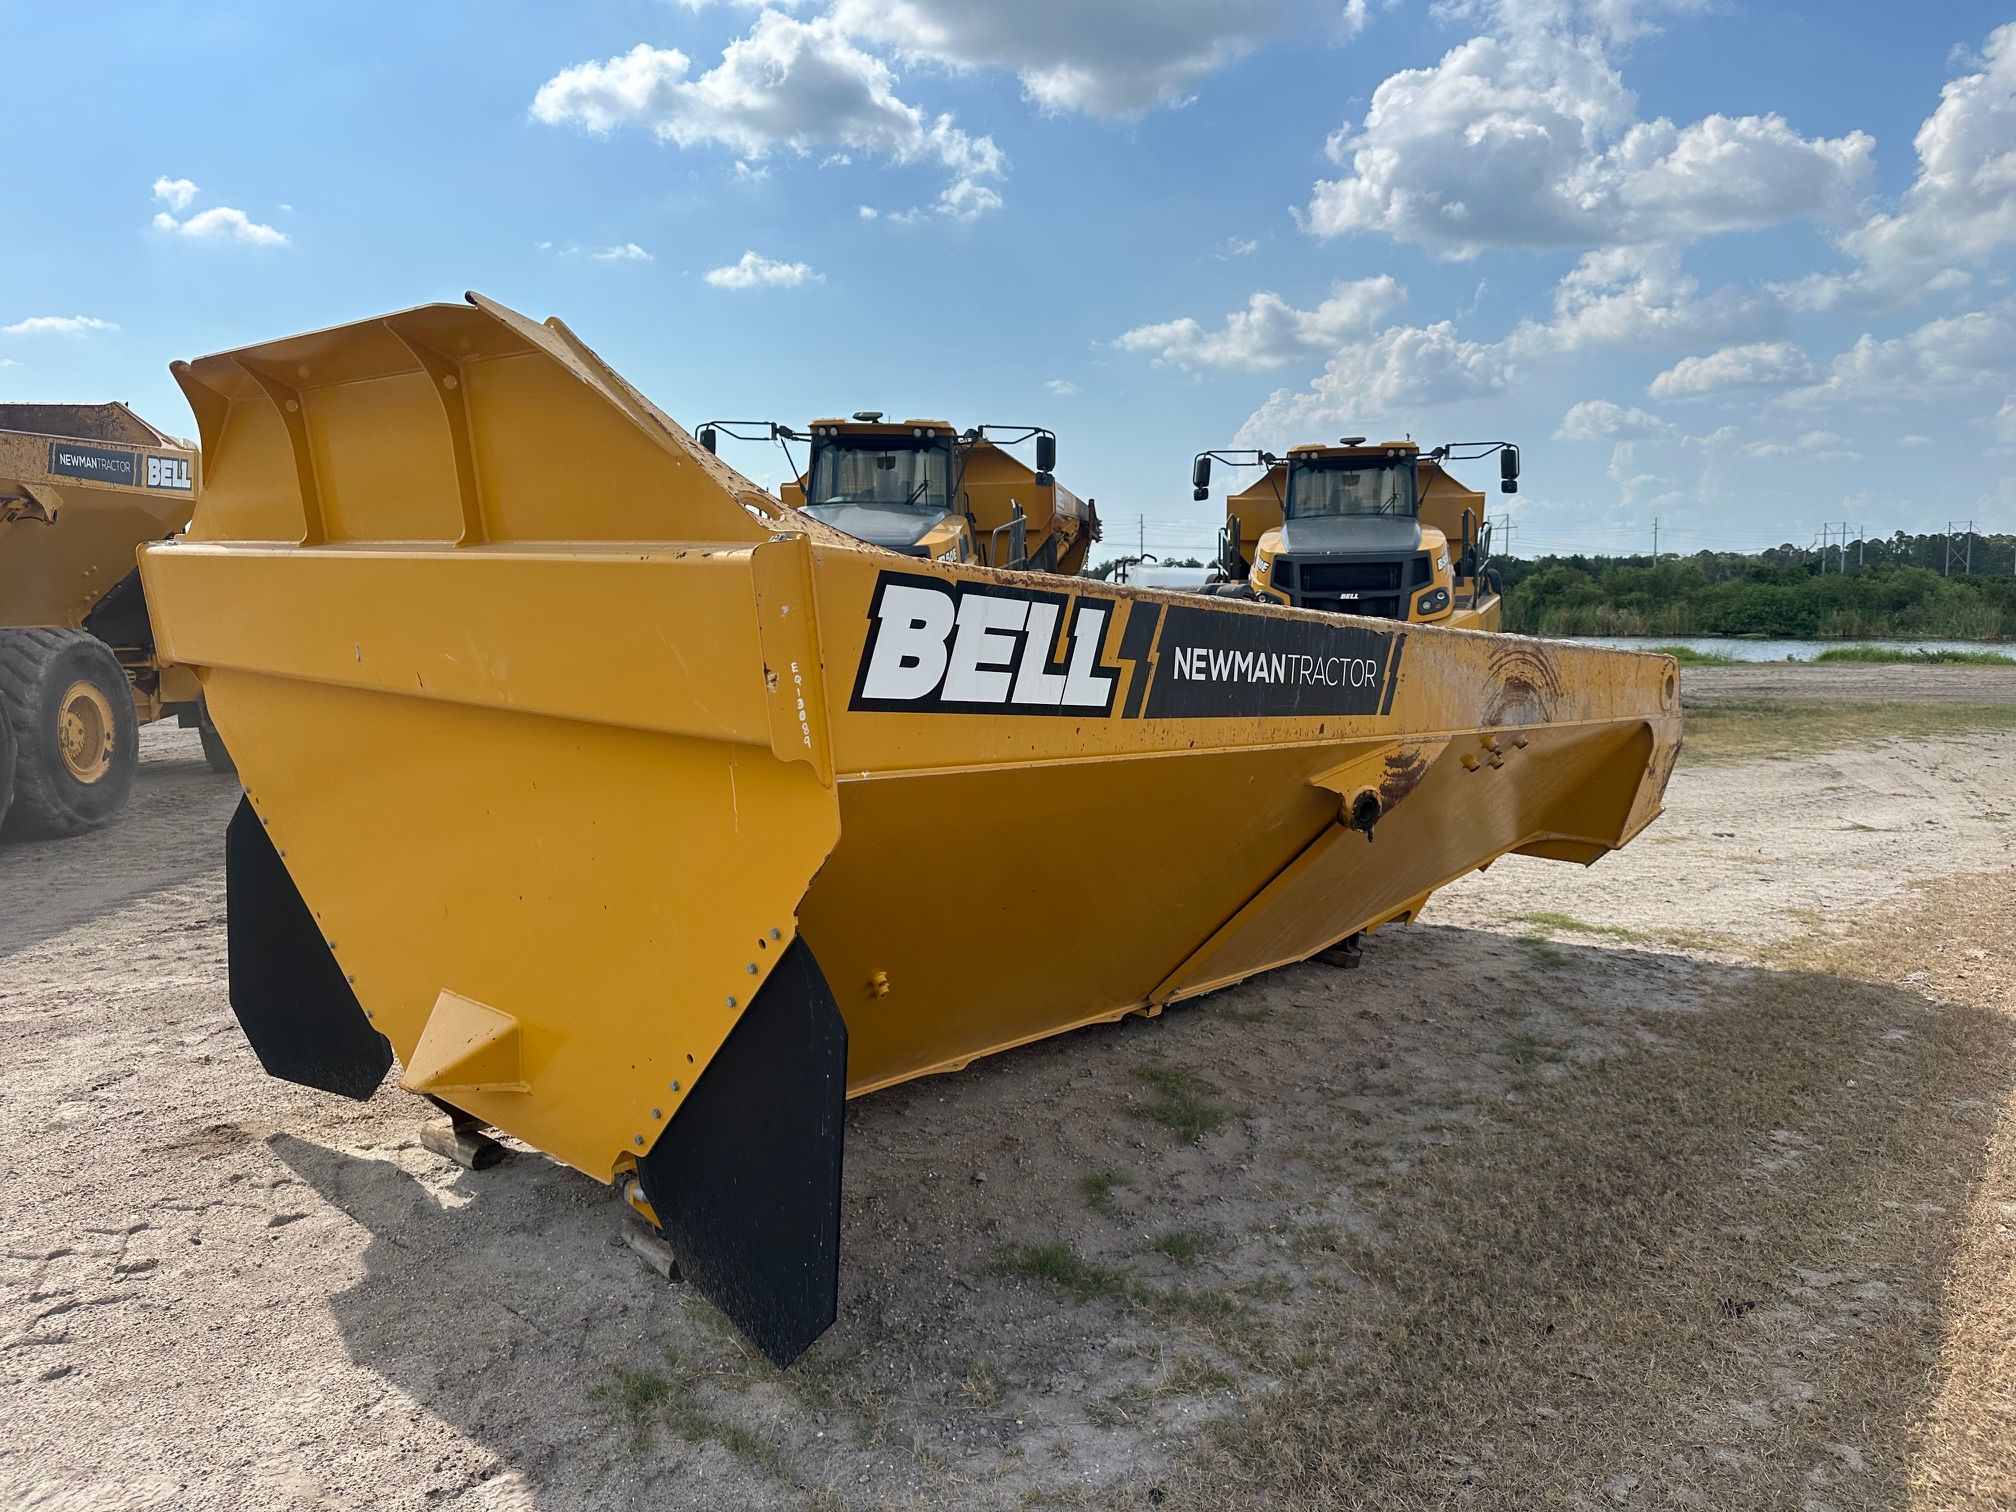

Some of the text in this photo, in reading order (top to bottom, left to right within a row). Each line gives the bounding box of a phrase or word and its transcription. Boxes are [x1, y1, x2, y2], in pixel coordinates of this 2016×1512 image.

[60, 453, 131, 473] NEWMANTRACTOR
[147, 457, 191, 489] BELL
[861, 584, 1112, 706] BELL
[1173, 646, 1377, 688] NEWMANTRACTOR
